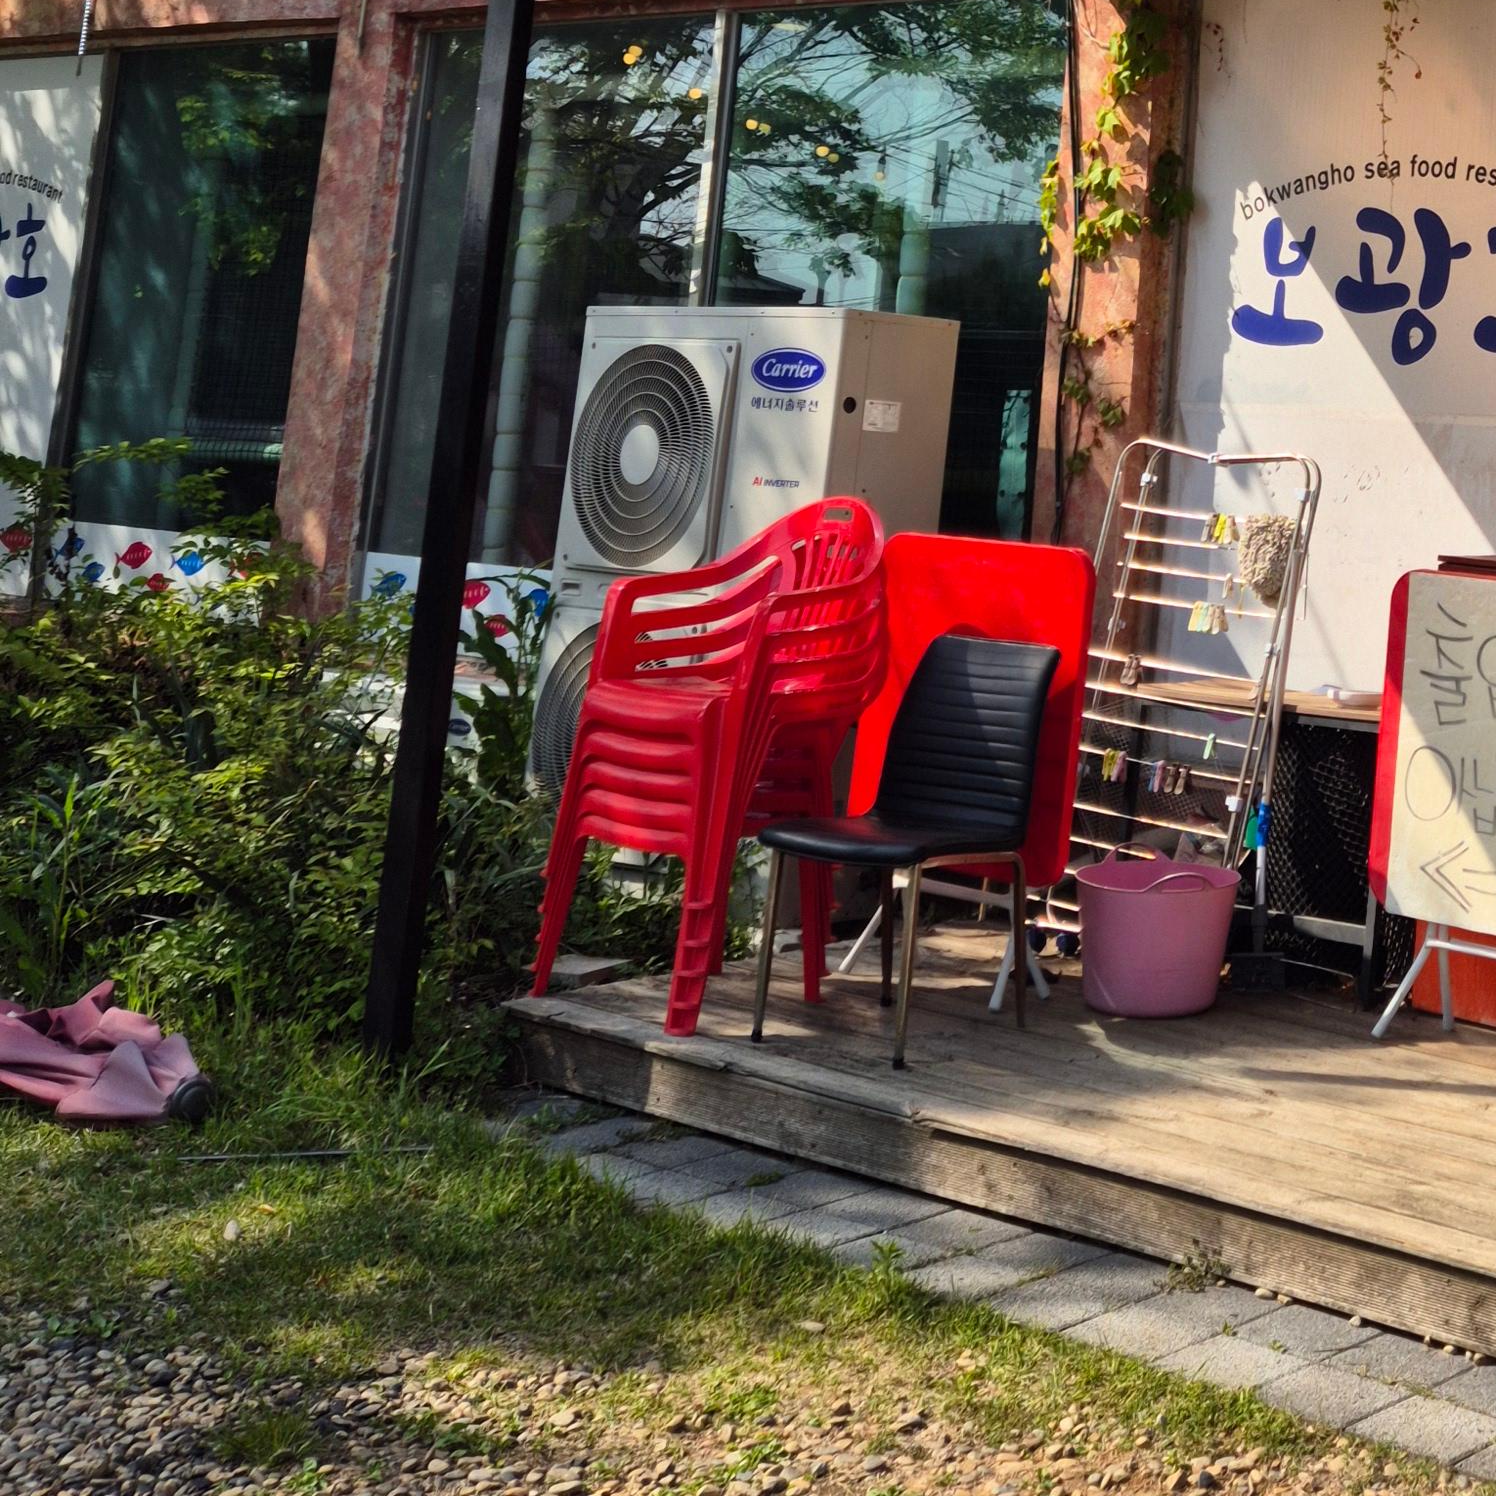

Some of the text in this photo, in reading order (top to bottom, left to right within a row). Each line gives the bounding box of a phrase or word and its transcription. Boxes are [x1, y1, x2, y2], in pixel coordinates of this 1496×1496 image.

[12, 173, 62, 203] restaurant
[1240, 163, 1355, 220] bokwangho
[1364, 159, 1401, 179] sea
[1410, 154, 1457, 180] food
[762, 358, 819, 379] Carrier
[751, 396, 819, 413] 에너지솔루션
[752, 476, 800, 489] AI INVERTER
